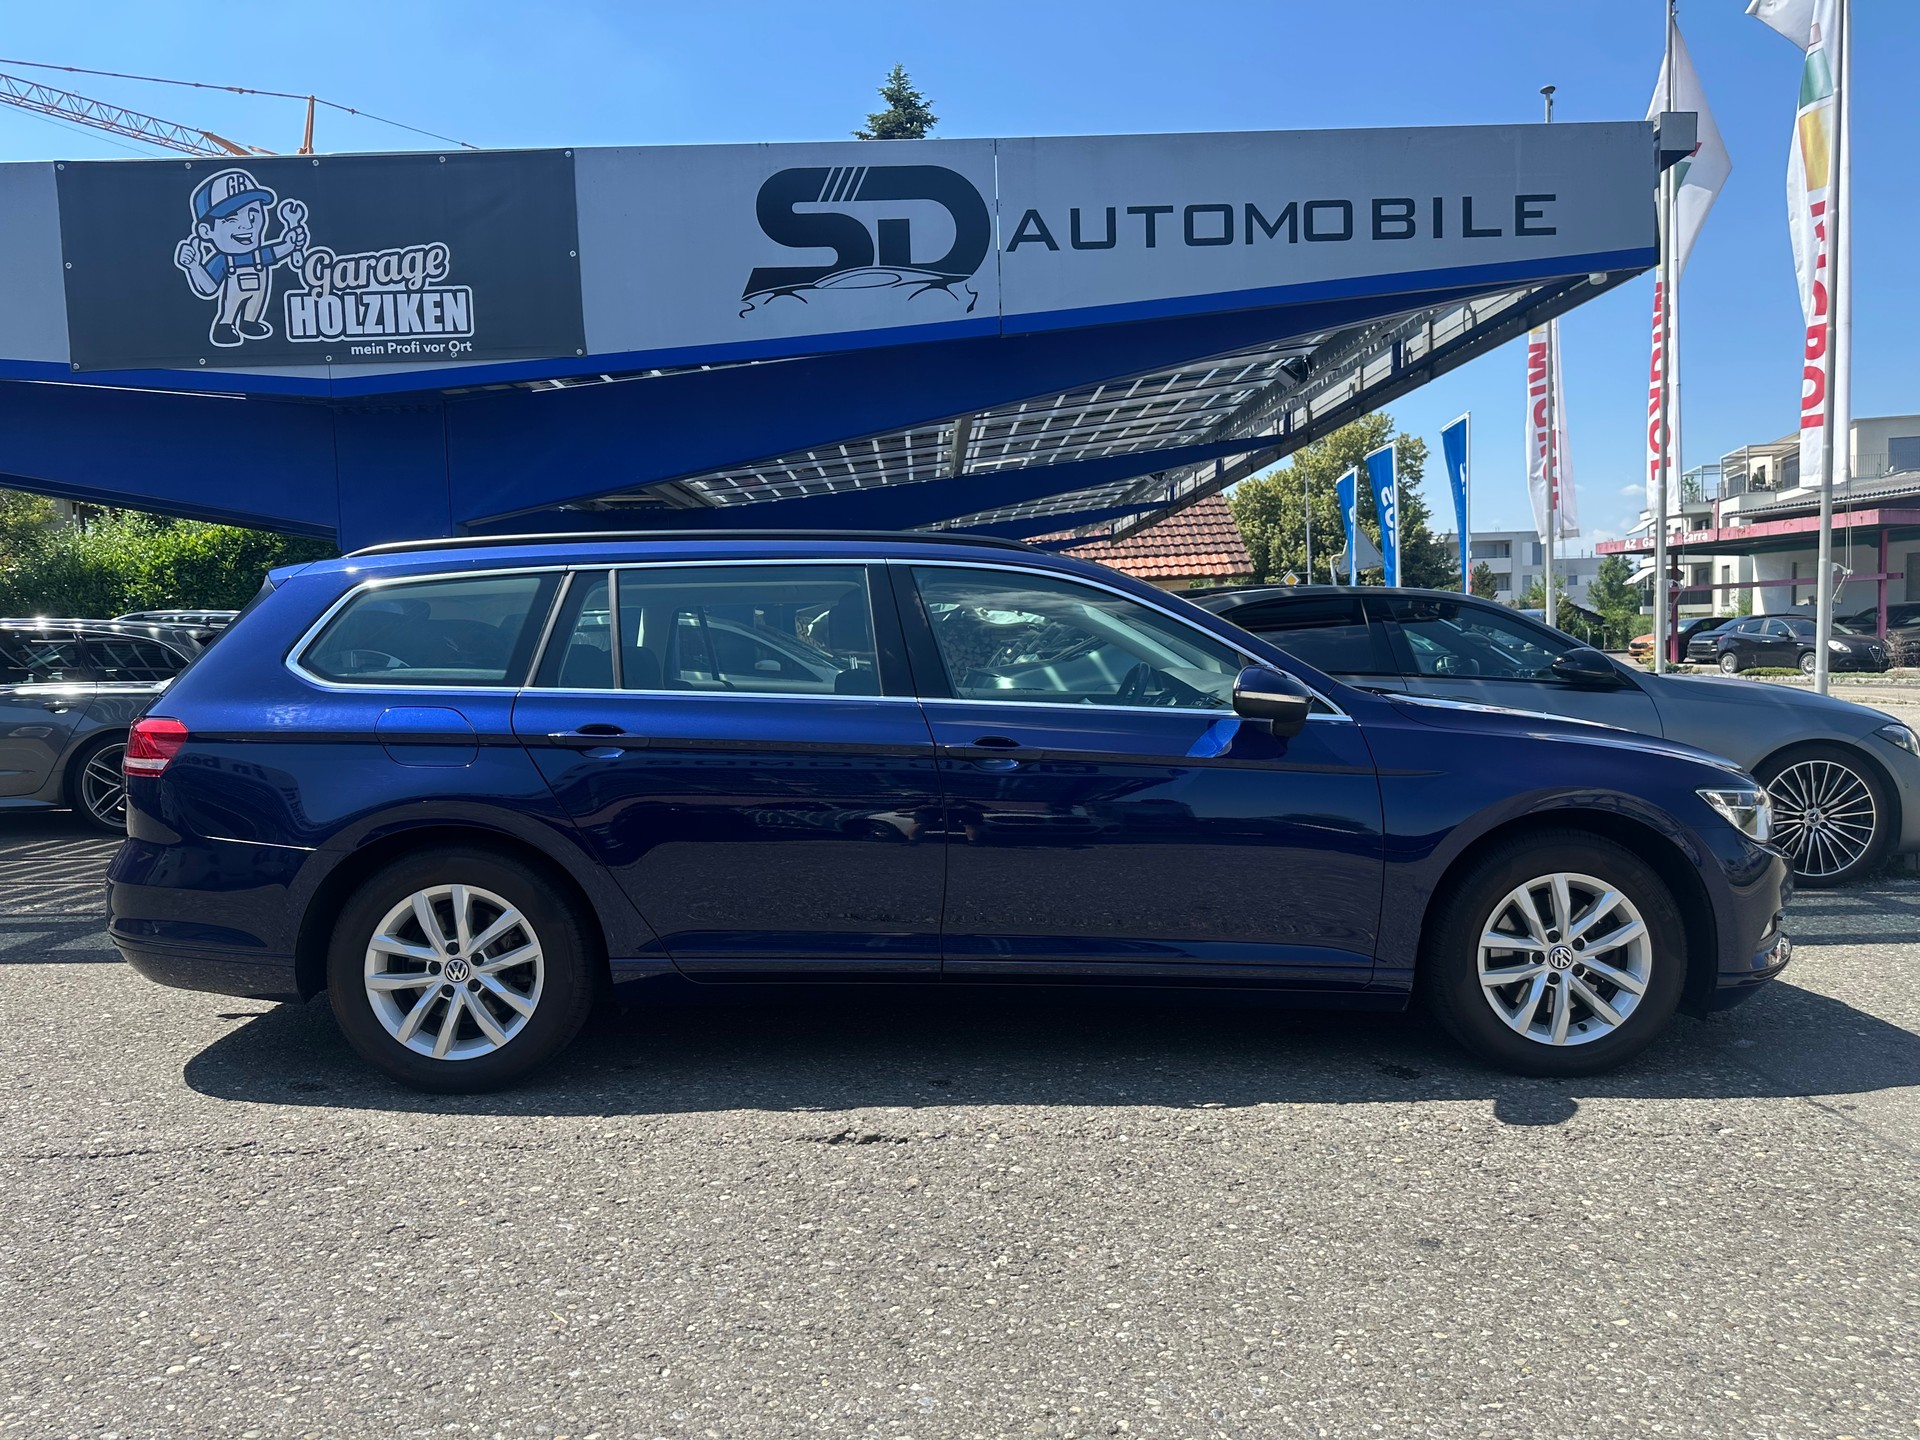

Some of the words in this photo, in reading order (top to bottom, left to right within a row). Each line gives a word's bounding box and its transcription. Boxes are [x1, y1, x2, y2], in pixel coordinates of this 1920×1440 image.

[741, 164, 992, 298] SD
[1005, 193, 1558, 253] AUTOMOBILE
[304, 248, 444, 301] Garage
[289, 291, 468, 336] HOLZIKEN
[350, 342, 384, 355] mein
[387, 340, 420, 354] Profi
[422, 343, 445, 353] vor
[448, 340, 472, 353] Ort
[1624, 538, 1637, 550] AZ
[1642, 536, 1675, 547] Gae
[445, 958, 470, 983] VW
